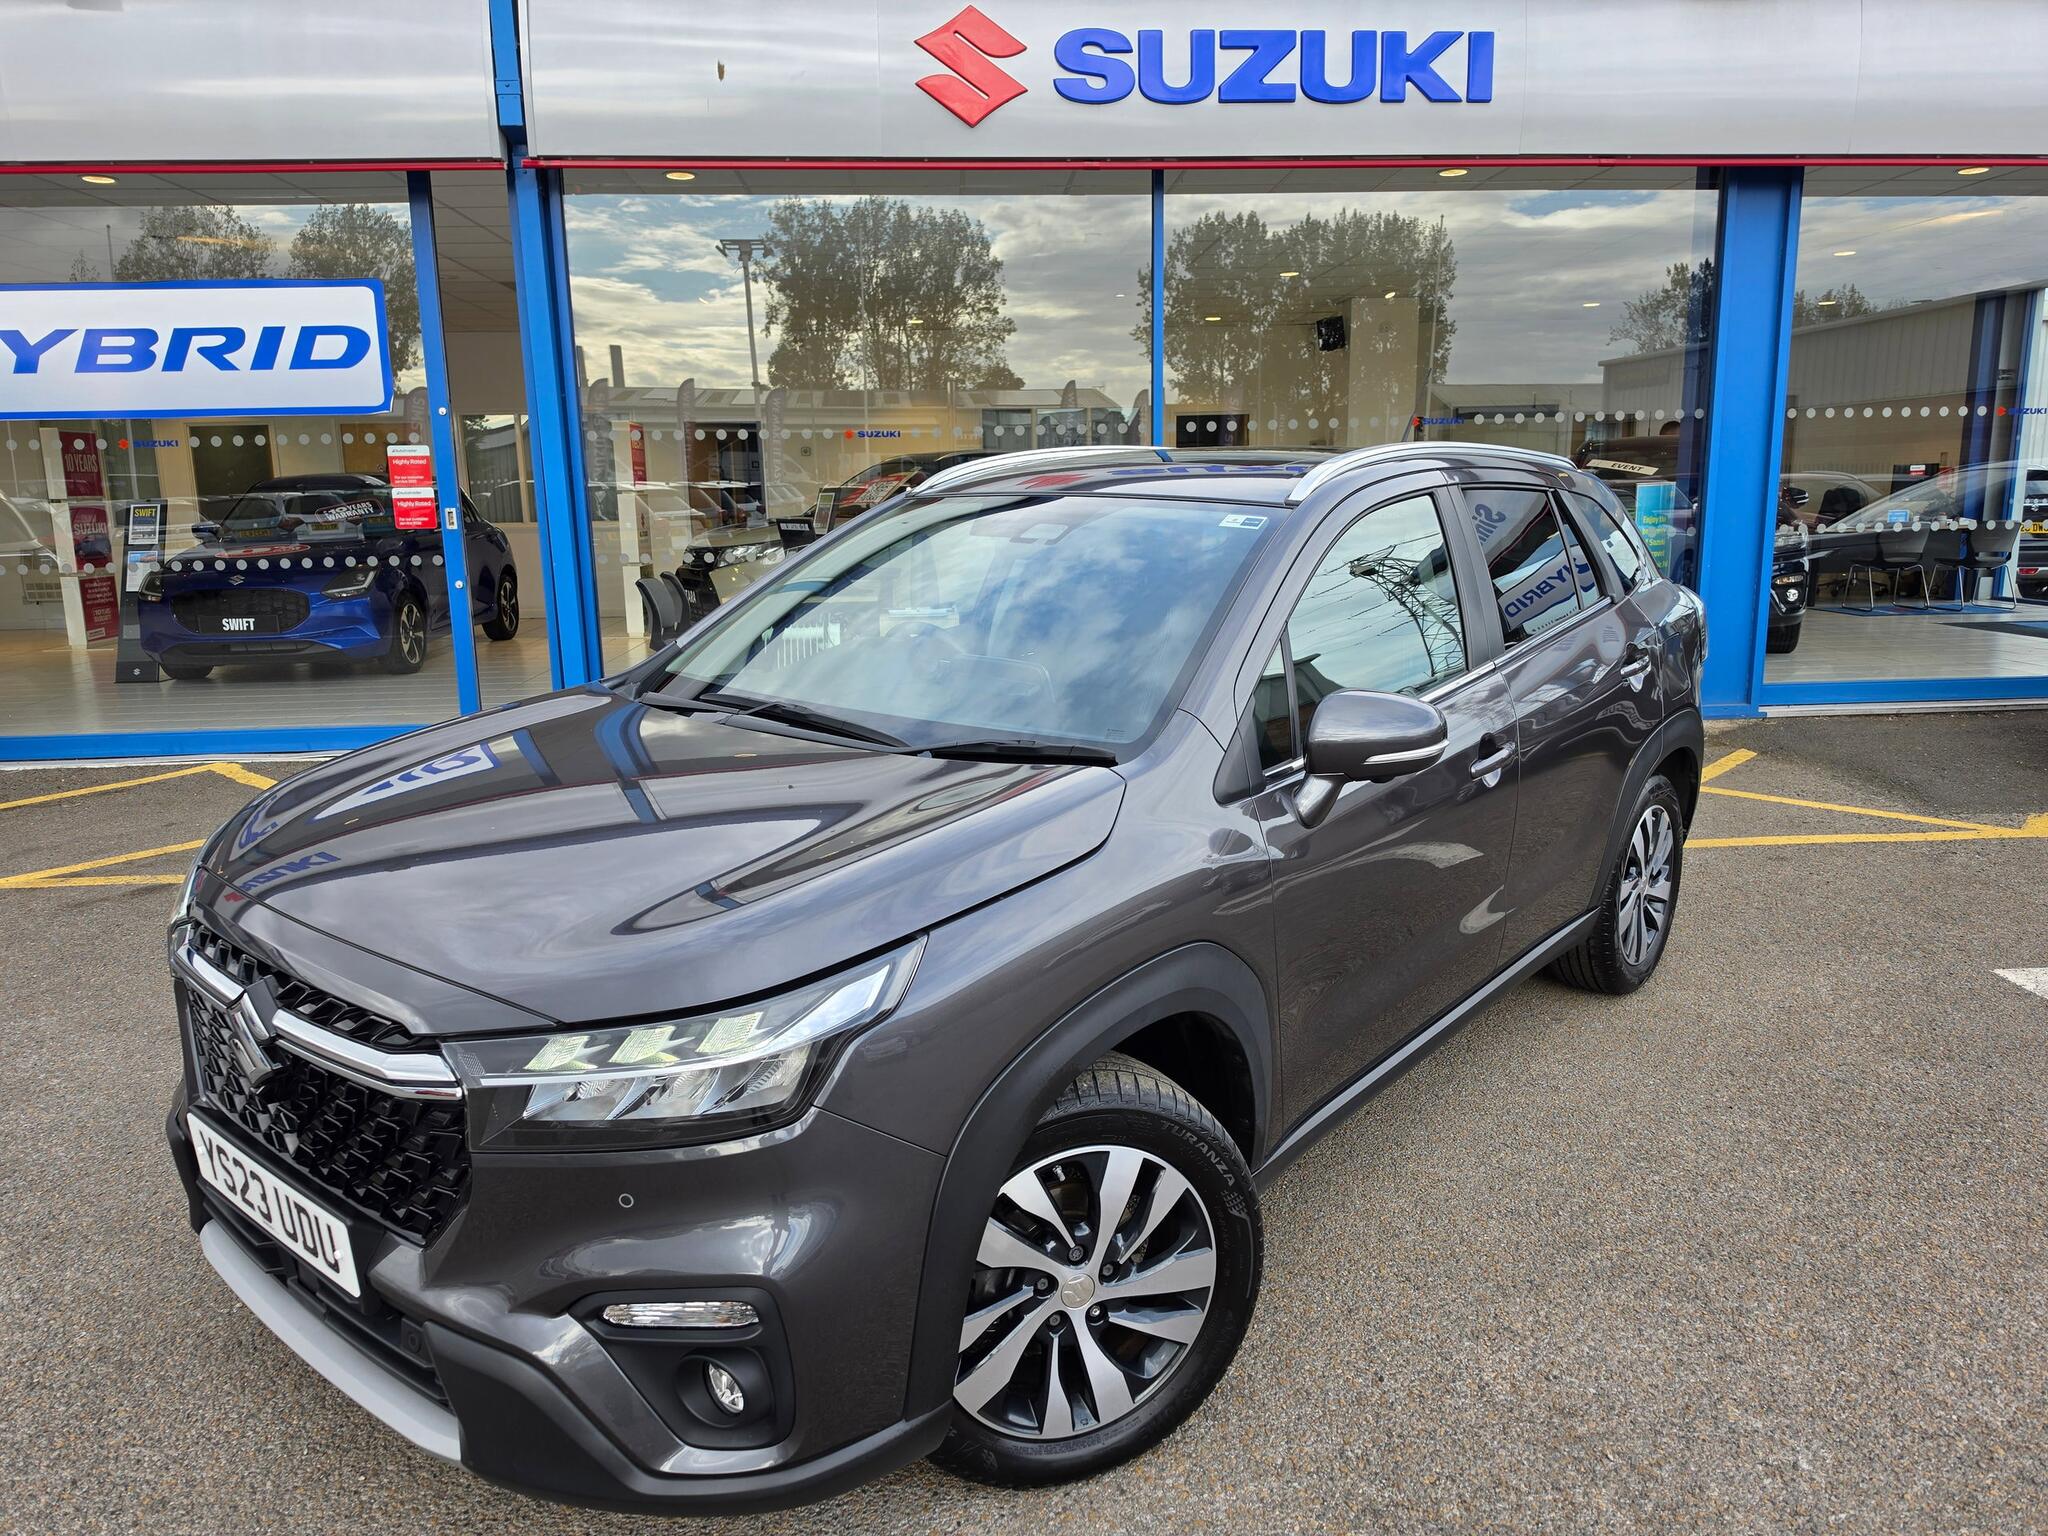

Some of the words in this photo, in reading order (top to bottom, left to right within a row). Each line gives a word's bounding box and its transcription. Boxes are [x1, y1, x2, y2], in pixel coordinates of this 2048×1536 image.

[1053, 27, 1494, 104] SUZUKI
[2008, 407, 2047, 415] SUZUKI
[1422, 416, 1465, 425] SUZUKI
[857, 430, 901, 438] SUZUKI
[133, 440, 178, 448] SUZUKI
[65, 454, 74, 472] 10
[76, 453, 98, 473] YEARS
[1611, 462, 1645, 473] EVENT
[134, 508, 156, 517] SWIFT
[347, 502, 372, 511] YEARS
[325, 507, 374, 521] WARRANTY
[73, 522, 107, 535] SUZUKI
[222, 618, 255, 631] SWIFT
[1160, 1120, 1236, 1187] TURANZA
[199, 1129, 273, 1224] YS23
[273, 1186, 340, 1274] UDU
